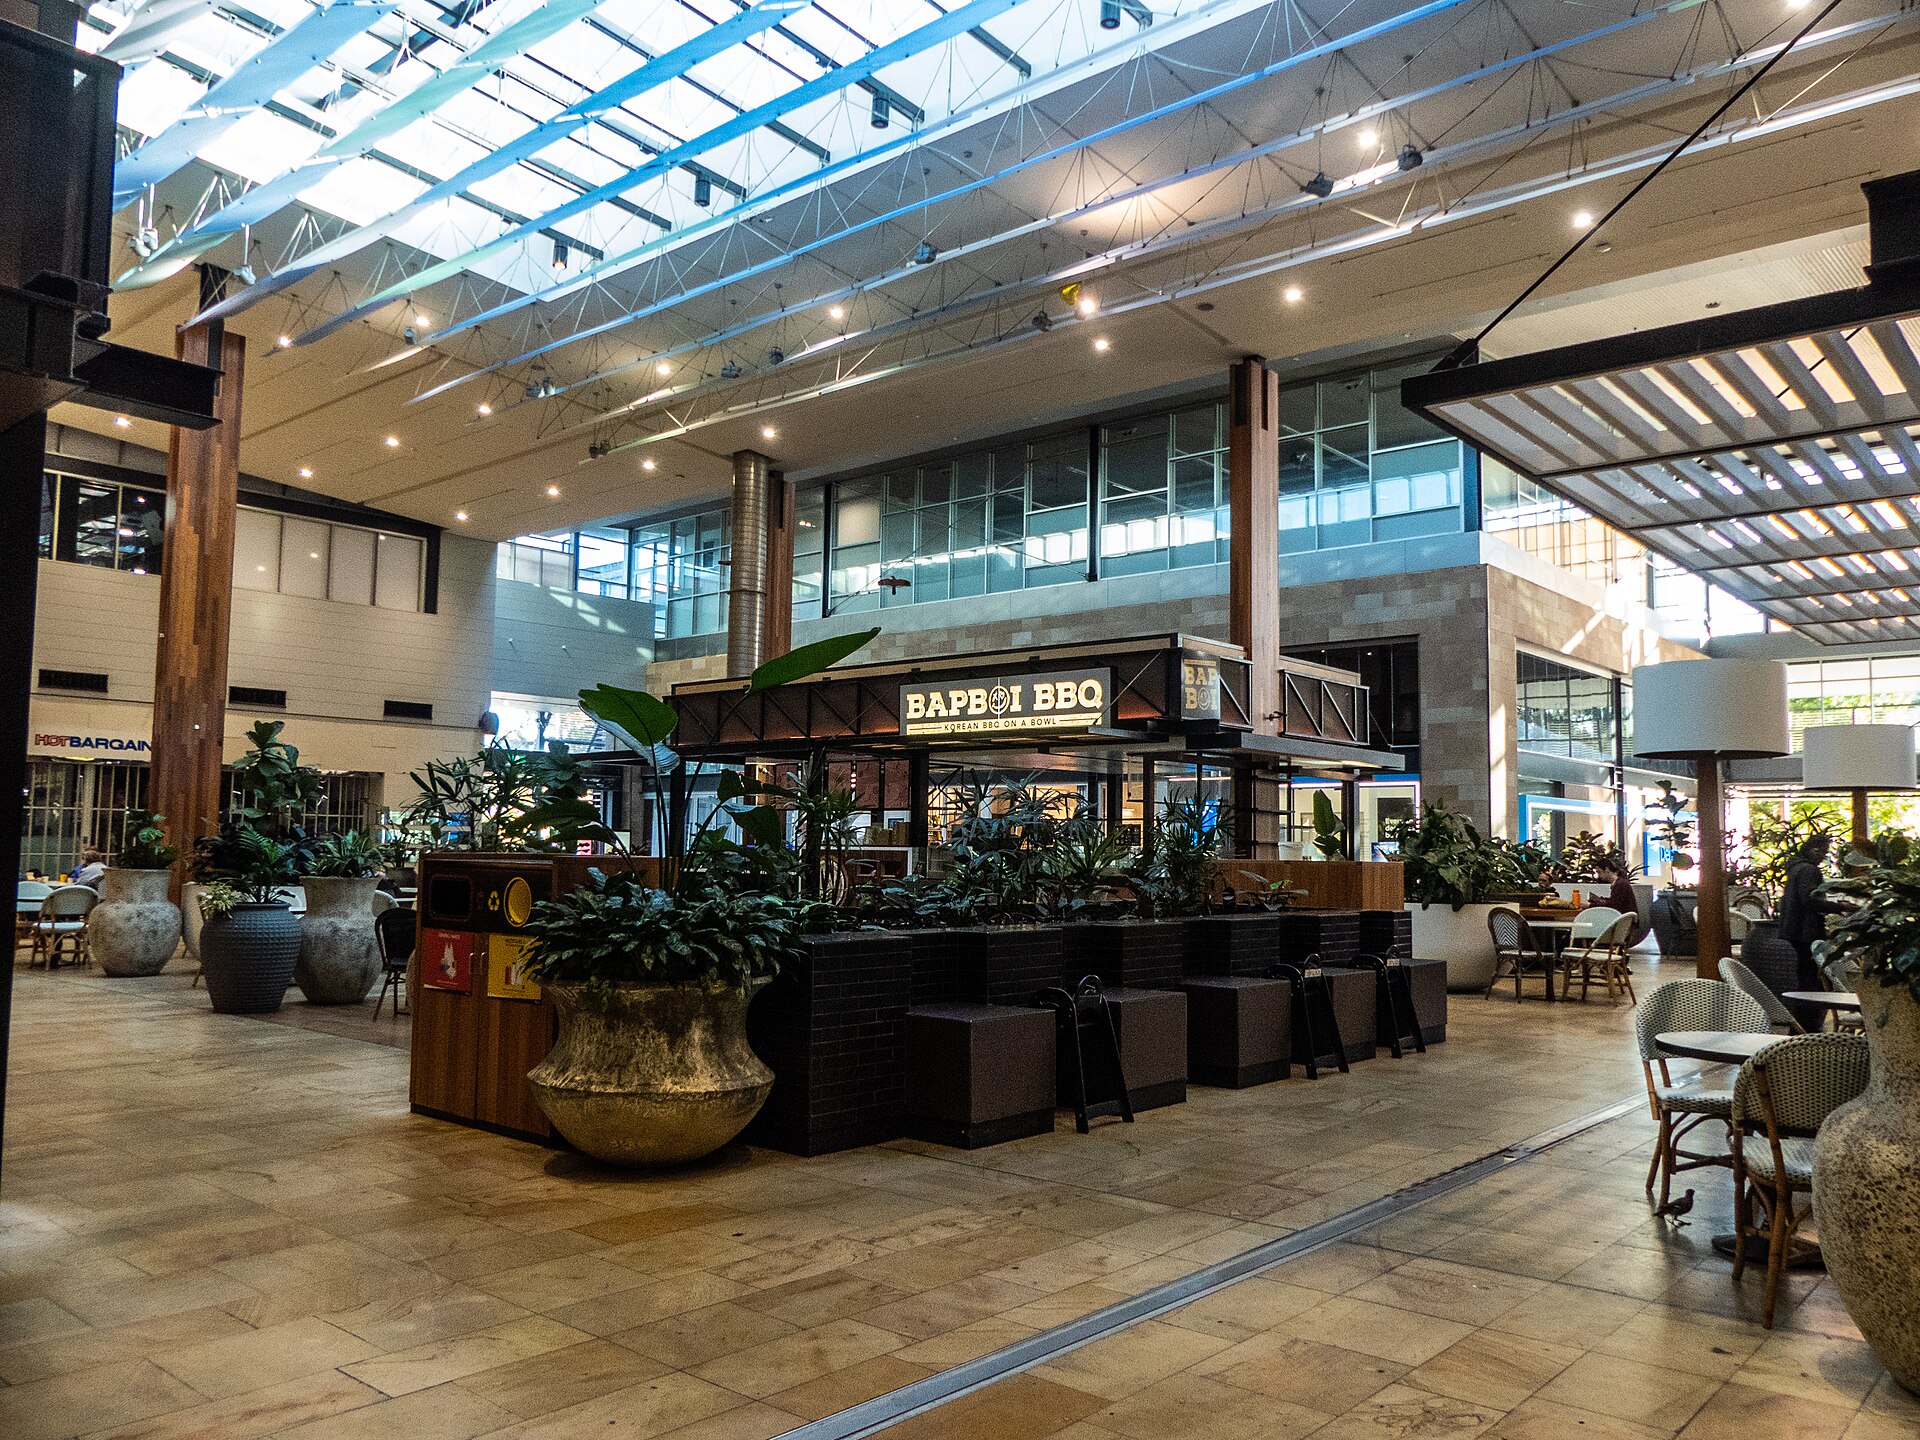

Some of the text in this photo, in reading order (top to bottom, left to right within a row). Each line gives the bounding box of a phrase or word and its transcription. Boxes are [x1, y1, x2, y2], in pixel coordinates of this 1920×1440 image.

[1184, 666, 1218, 686] BAP
[906, 678, 1103, 720] BAPBOI BBQ
[944, 716, 1057, 732] KOREAN BBQ ON A BOWL
